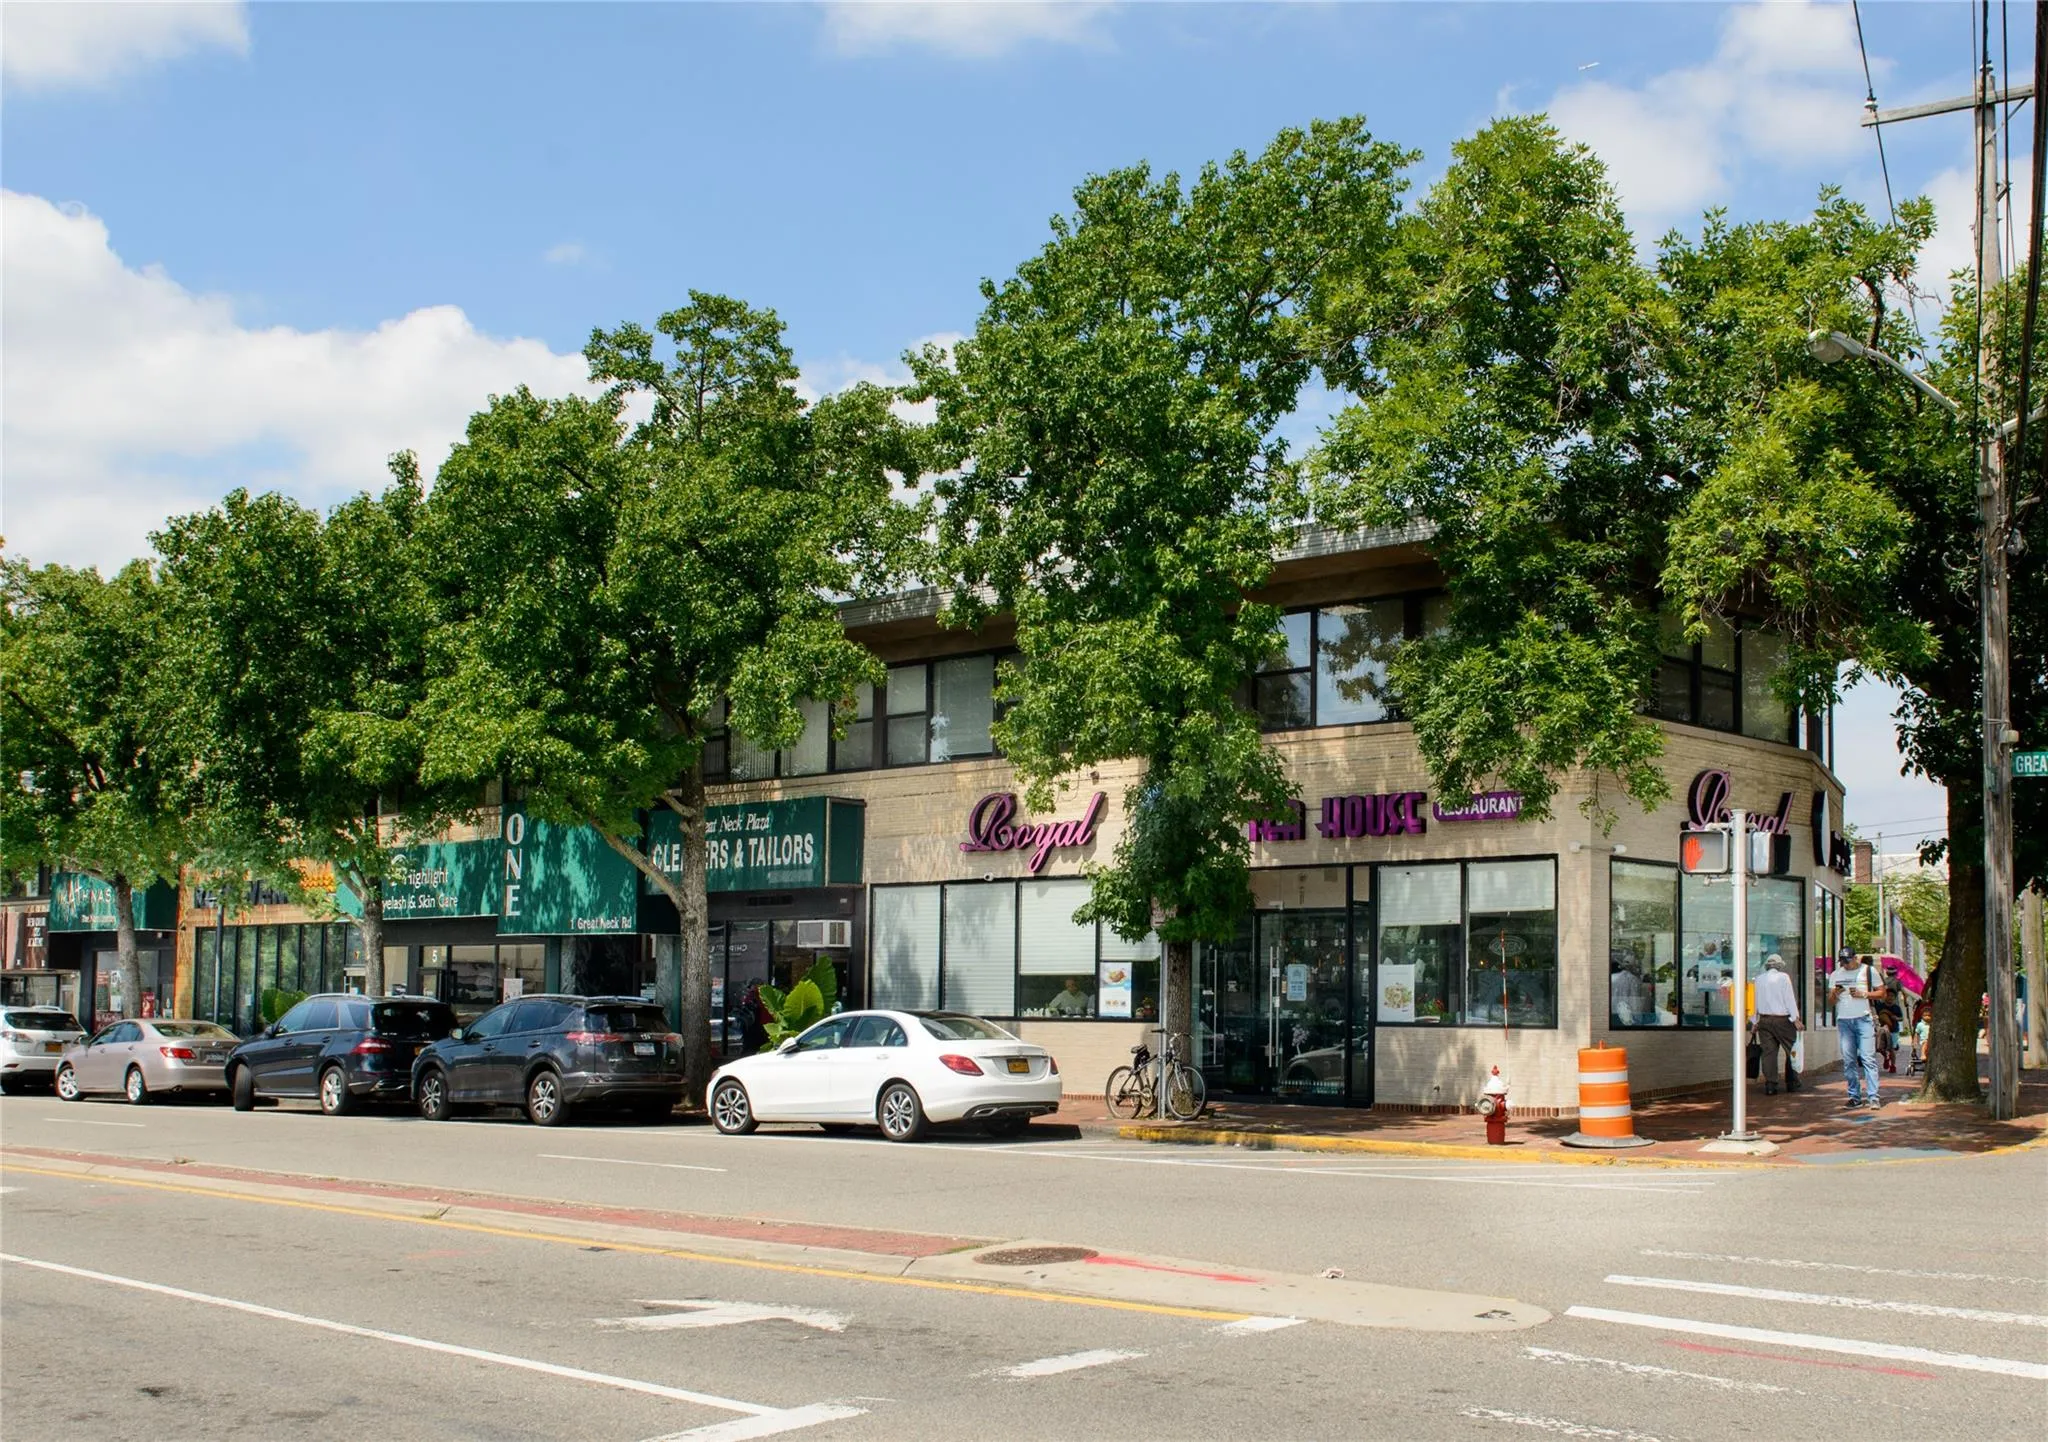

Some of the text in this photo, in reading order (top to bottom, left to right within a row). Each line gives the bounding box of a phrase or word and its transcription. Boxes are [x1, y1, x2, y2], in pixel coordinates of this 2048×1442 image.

[2016, 755, 2048, 773] GREA
[1316, 791, 1427, 839] HOUSE
[1682, 769, 1794, 834] Ral
[705, 812, 769, 833] eat Neck Plaza
[960, 791, 1106, 873] Royal
[506, 813, 525, 916] ONE
[653, 832, 814, 872] CLERS & TAILORS
[382, 895, 407, 913] yelash
[418, 895, 436, 909] Skin
[438, 892, 458, 908] Care
[577, 917, 599, 930] Great
[600, 917, 619, 929] Neck
[621, 915, 632, 929] Rd
[431, 949, 438, 963] 5
